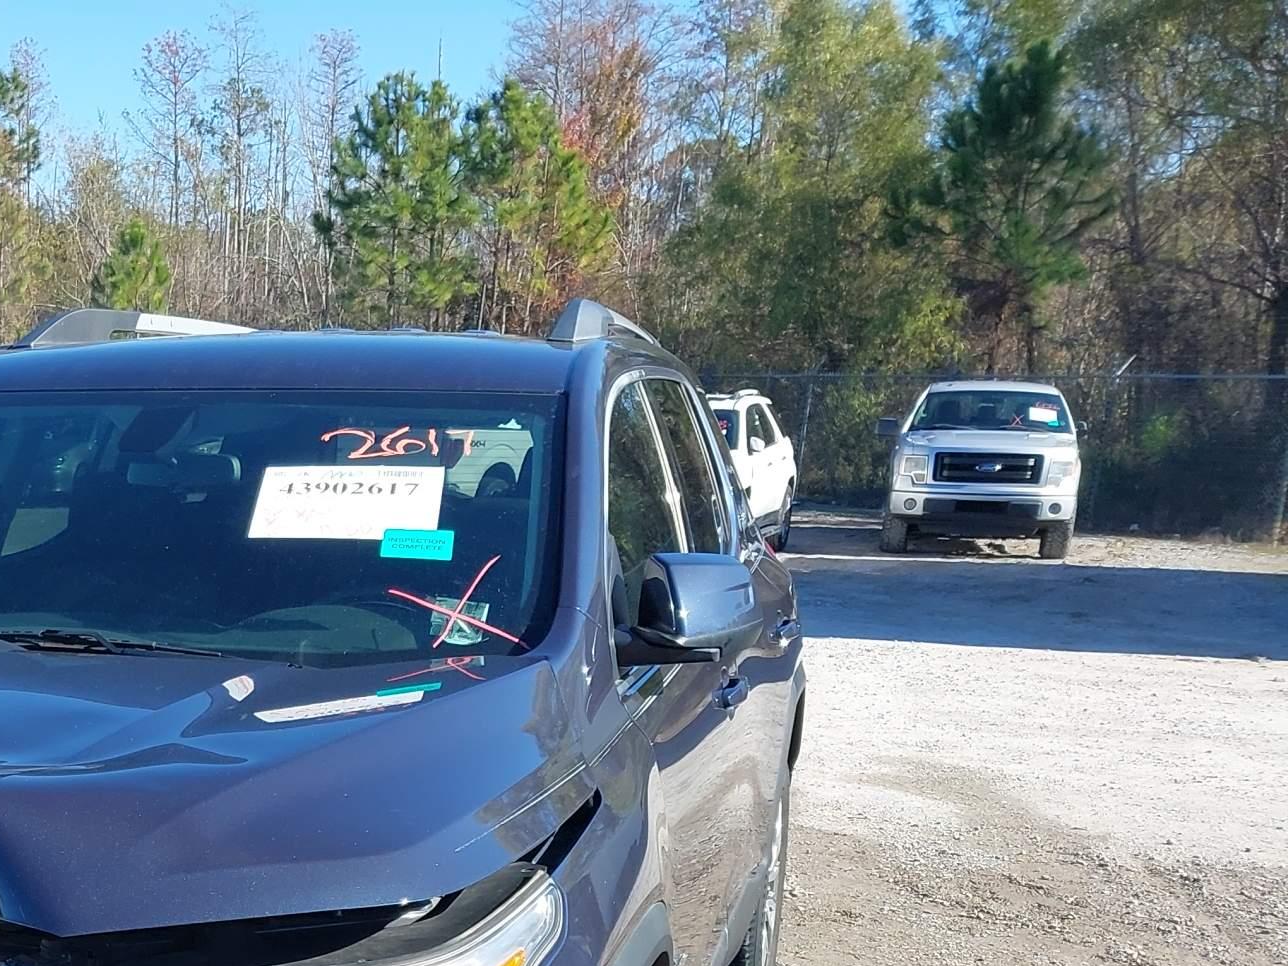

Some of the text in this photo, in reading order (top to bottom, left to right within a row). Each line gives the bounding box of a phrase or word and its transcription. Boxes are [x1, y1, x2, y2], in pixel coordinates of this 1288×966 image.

[321, 426, 474, 458] 2617
[279, 482, 419, 496] 43902617
[387, 537, 446, 545] INSPECTION
[391, 543, 443, 551] COMPLETE
